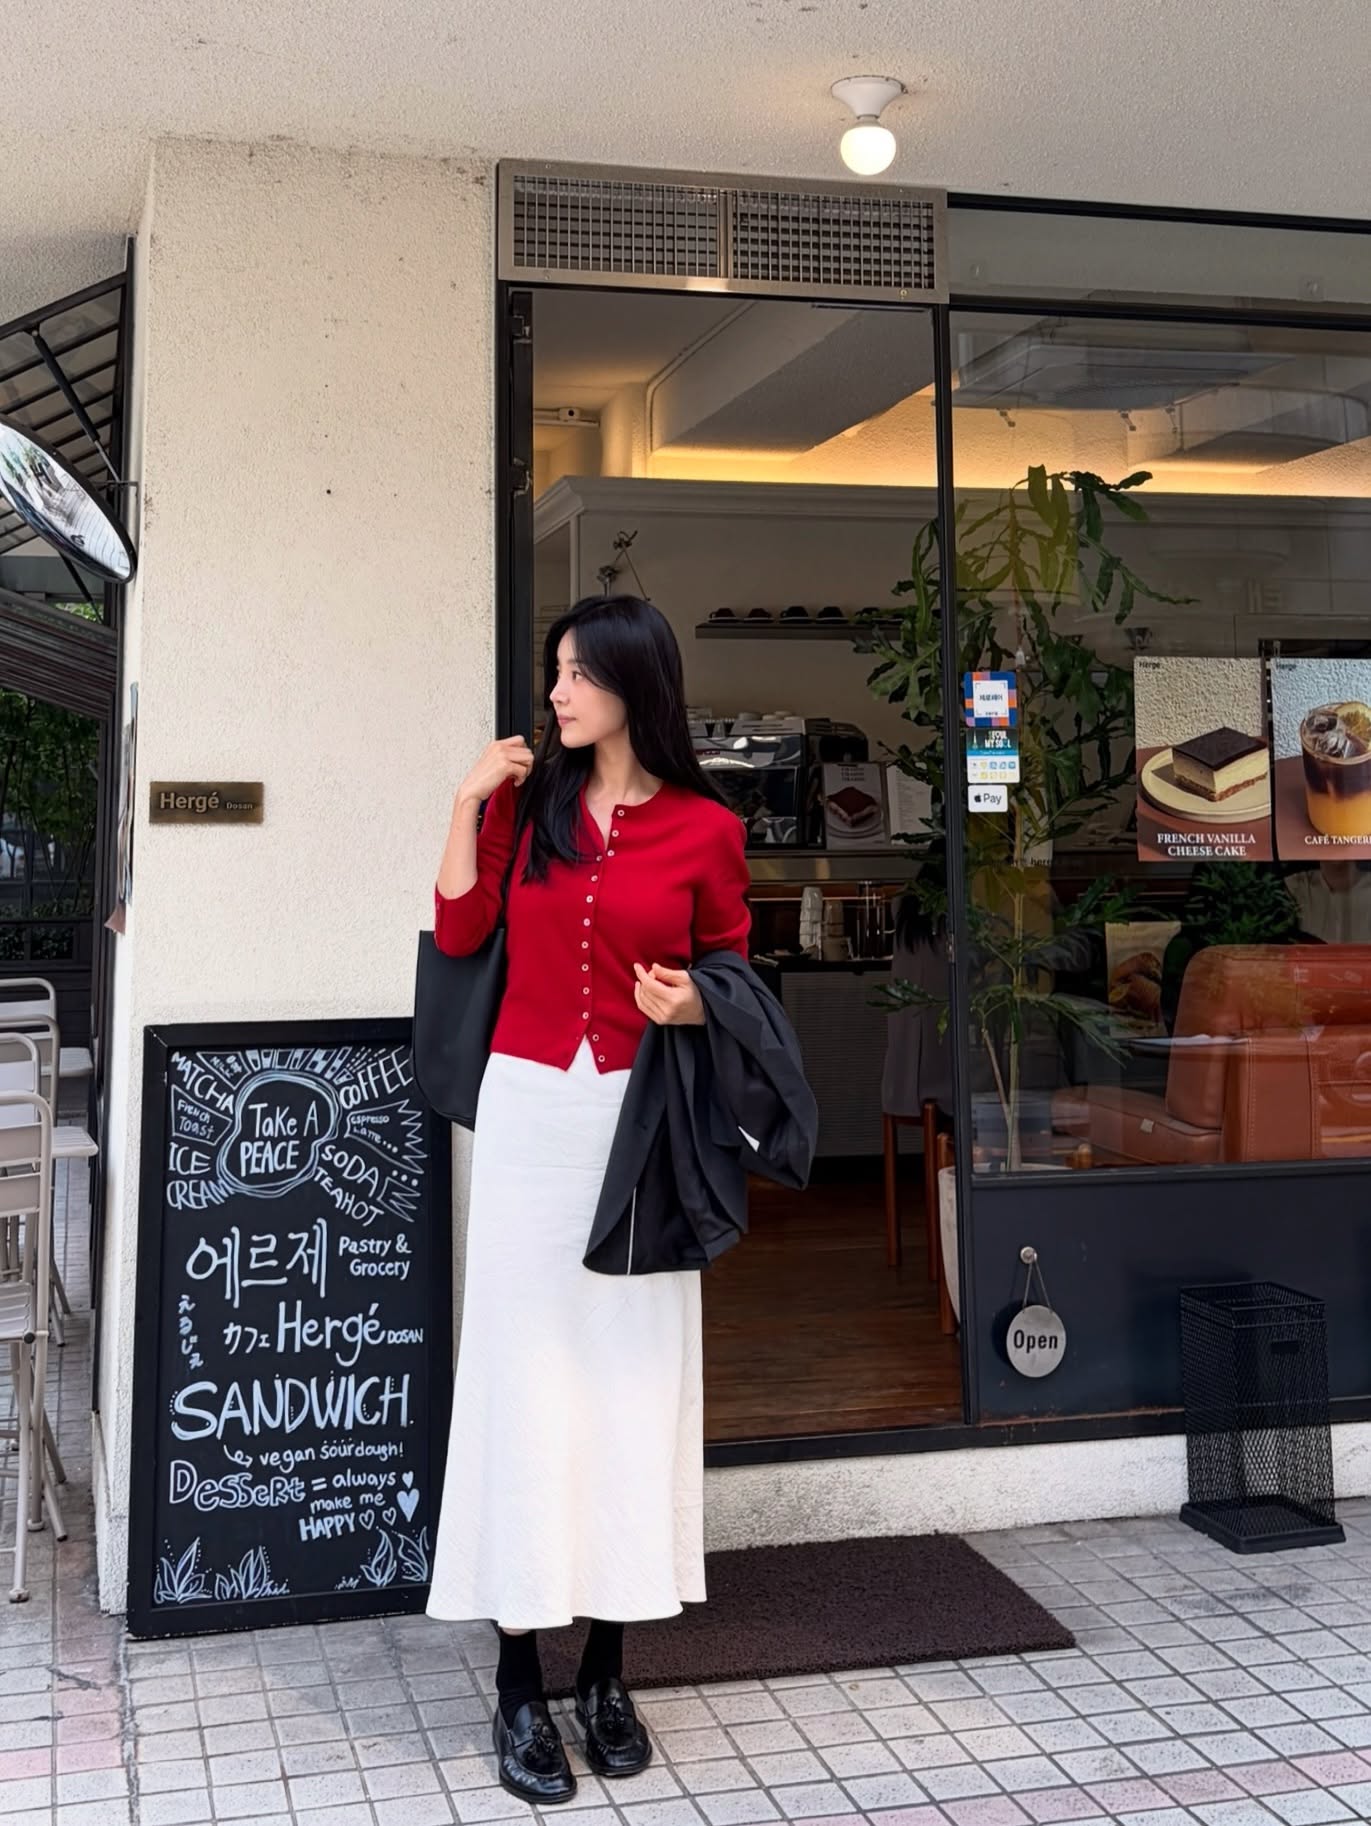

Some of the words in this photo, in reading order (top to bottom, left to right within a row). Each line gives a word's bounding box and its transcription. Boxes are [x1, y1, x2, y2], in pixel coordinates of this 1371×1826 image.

[160, 791, 220, 813] Hergé
[983, 792, 1002, 805] Pay
[1157, 833, 1204, 844] FRENCH
[1207, 833, 1256, 844] VANILLA
[1167, 846, 1214, 857] CHEESE
[1214, 846, 1247, 857] CAKE
[1304, 833, 1330, 845] CAFÉ
[171, 1051, 235, 1116] MATCHA
[339, 1045, 414, 1110] COFFEE
[303, 1100, 319, 1137] A
[168, 1142, 212, 1176] ICE
[240, 1140, 300, 1178] PEACE
[321, 1144, 380, 1198] SODA
[166, 1178, 236, 1211] CREAM
[339, 1235, 392, 1257] Pastry
[395, 1233, 412, 1254] &
[186, 1217, 328, 1309] 에르제
[349, 1258, 411, 1281] Grocery
[276, 1299, 386, 1367] Hergé
[387, 1328, 425, 1344] DOSAN
[1013, 1328, 1058, 1354] Open
[259, 1446, 316, 1474] vegan
[332, 1468, 396, 1490] always
[310, 1495, 353, 1514] make
[359, 1492, 387, 1507] me
[298, 1511, 356, 1542] HAPPY
